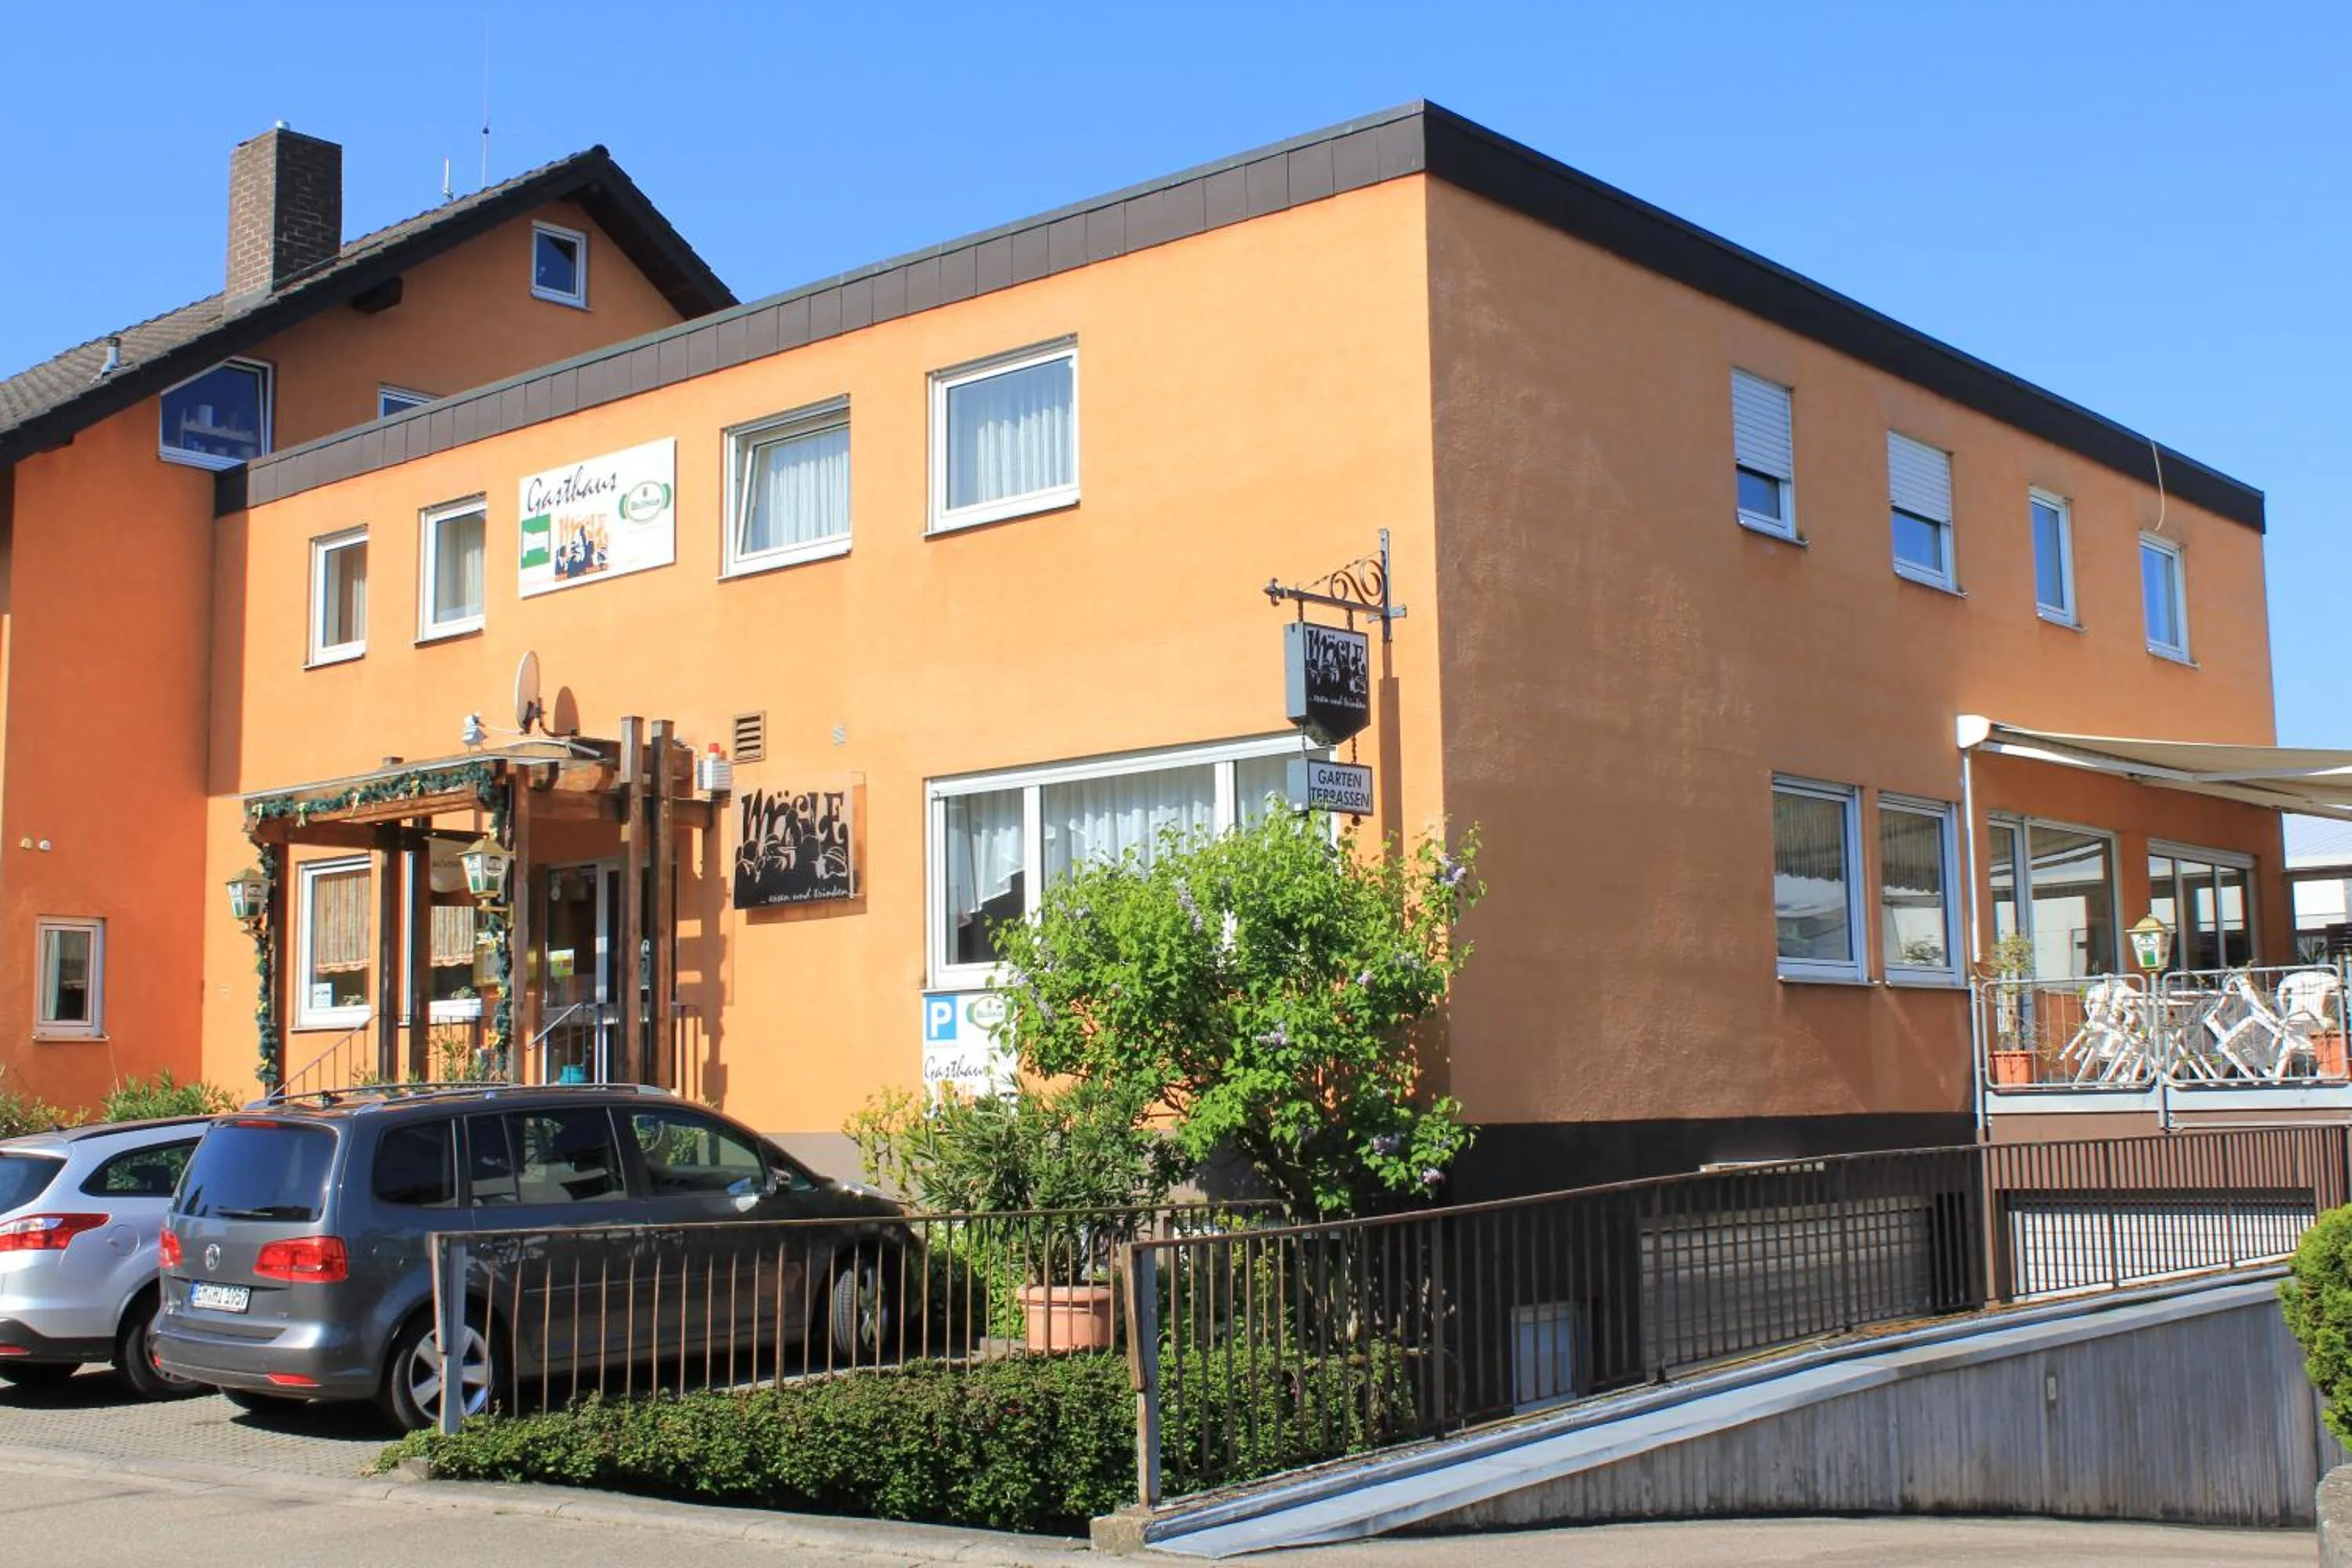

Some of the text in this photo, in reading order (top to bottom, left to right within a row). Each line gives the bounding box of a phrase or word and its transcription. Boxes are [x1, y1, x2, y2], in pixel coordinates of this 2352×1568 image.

[527, 465, 617, 517] Gasthaus
[1318, 769, 1362, 788] GARTEN
[1311, 787, 1370, 808] TERRASSEN
[931, 1001, 953, 1038] P
[925, 1054, 986, 1081] Gasthau
